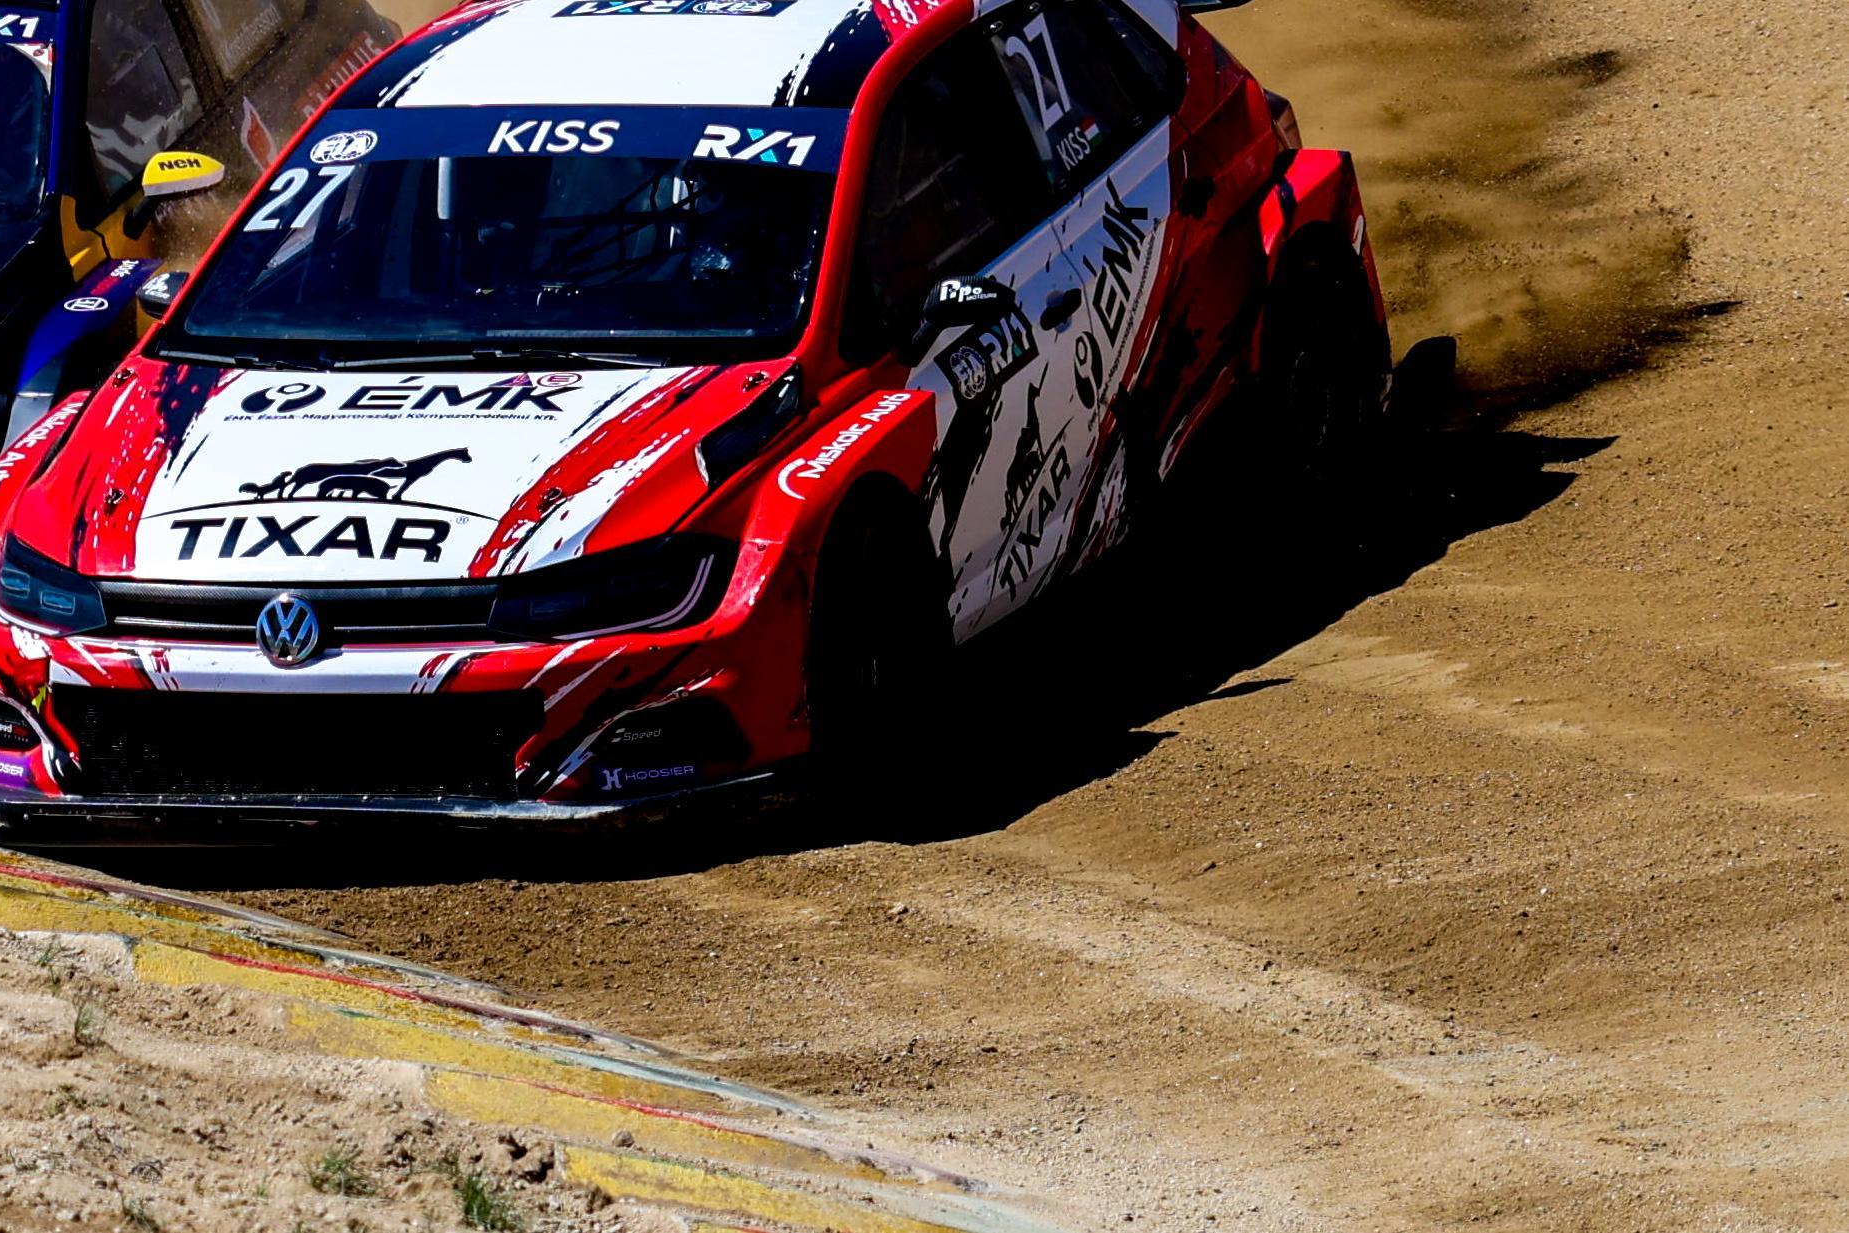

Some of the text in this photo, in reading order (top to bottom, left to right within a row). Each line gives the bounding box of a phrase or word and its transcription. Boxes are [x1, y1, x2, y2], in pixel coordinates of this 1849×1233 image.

[571, 0, 772, 15] RX1 FIA
[1003, 13, 1077, 135] 27
[310, 119, 817, 168] FIA KISS RX1
[1056, 126, 1092, 172] KISS
[242, 165, 357, 233] 27
[978, 311, 1031, 376] RX1
[337, 375, 585, 413] ÉMK
[169, 516, 452, 563] TIXAR
[998, 445, 1071, 603] TIXAR
[623, 728, 662, 741] Speed
[625, 765, 695, 781] HOOSIER
